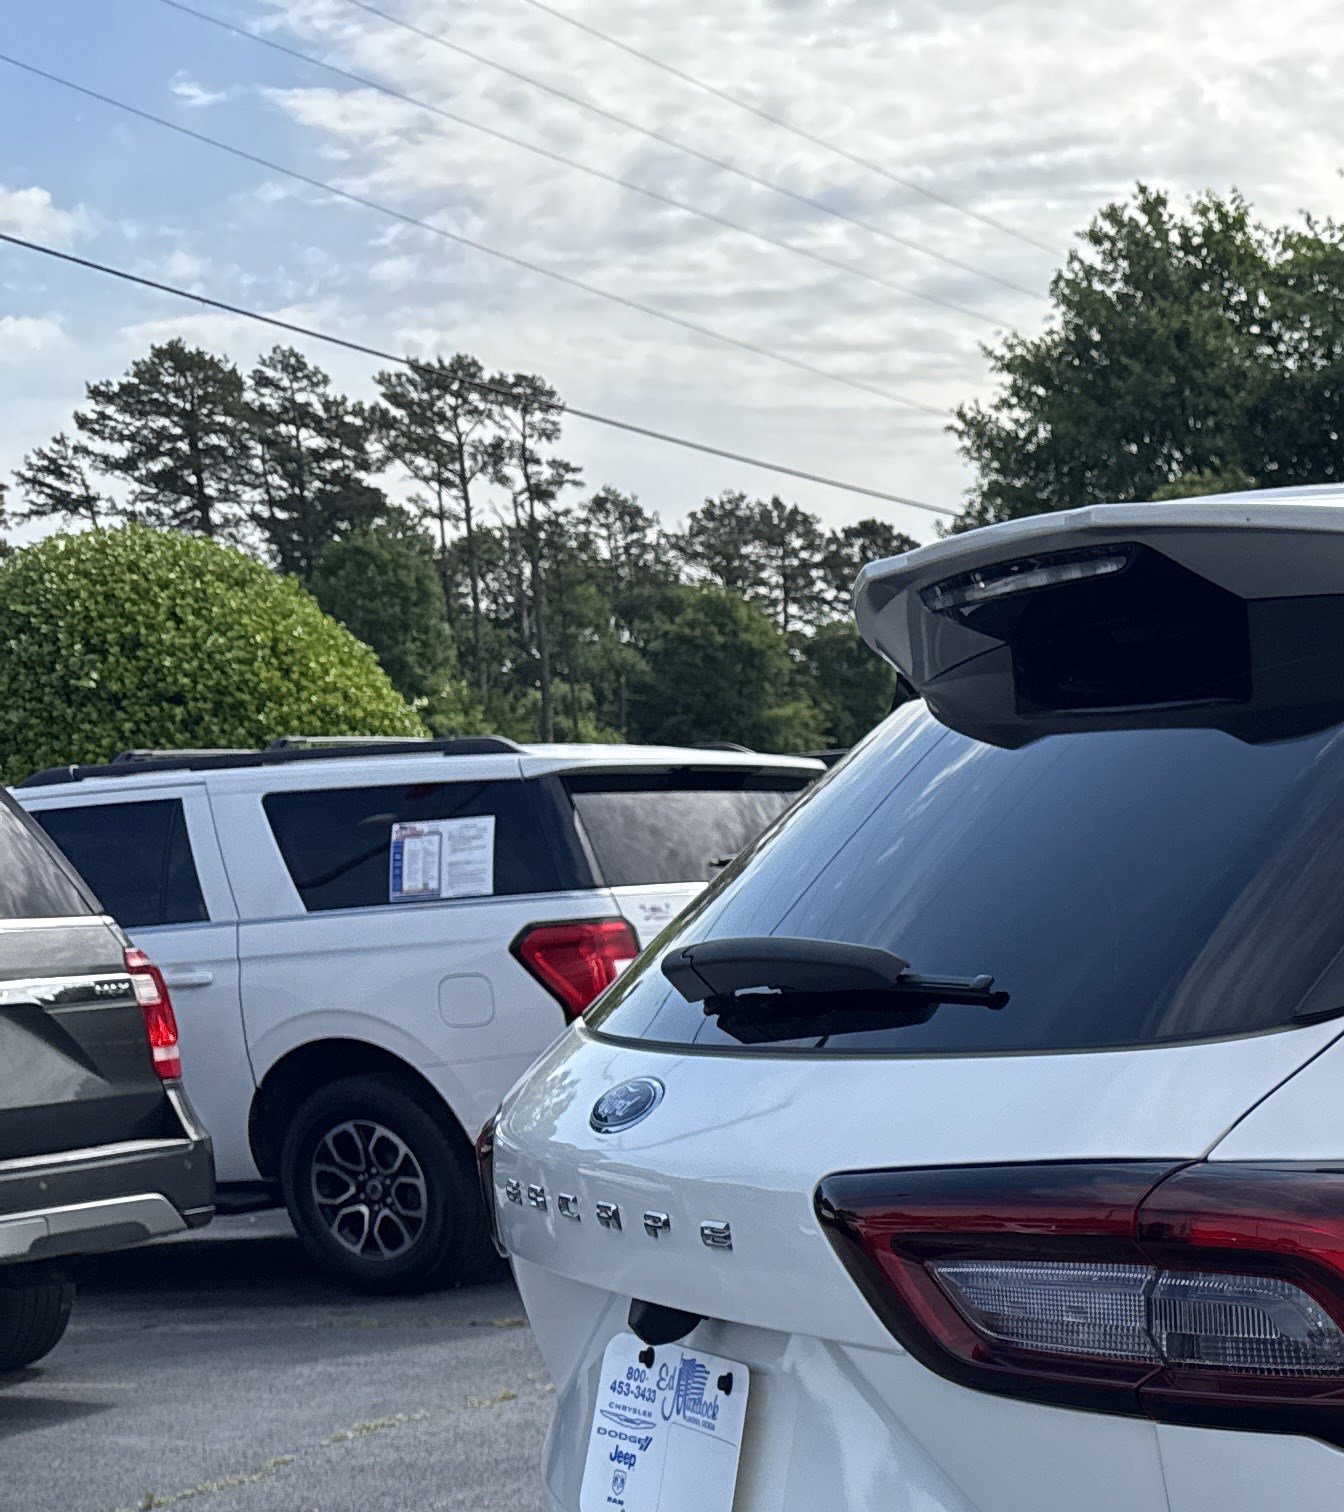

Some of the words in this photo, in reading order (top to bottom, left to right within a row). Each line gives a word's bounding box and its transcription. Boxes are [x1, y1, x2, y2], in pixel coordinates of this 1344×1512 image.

[505, 1177, 733, 1251] ESCAPE
[656, 1362, 677, 1390] Ed
[610, 1380, 656, 1403] 453-3433
[608, 1402, 653, 1418] CHRYSLER
[597, 1427, 648, 1446] DODGE
[609, 1444, 637, 1470] Jeep
[607, 1496, 624, 1506] RAM
